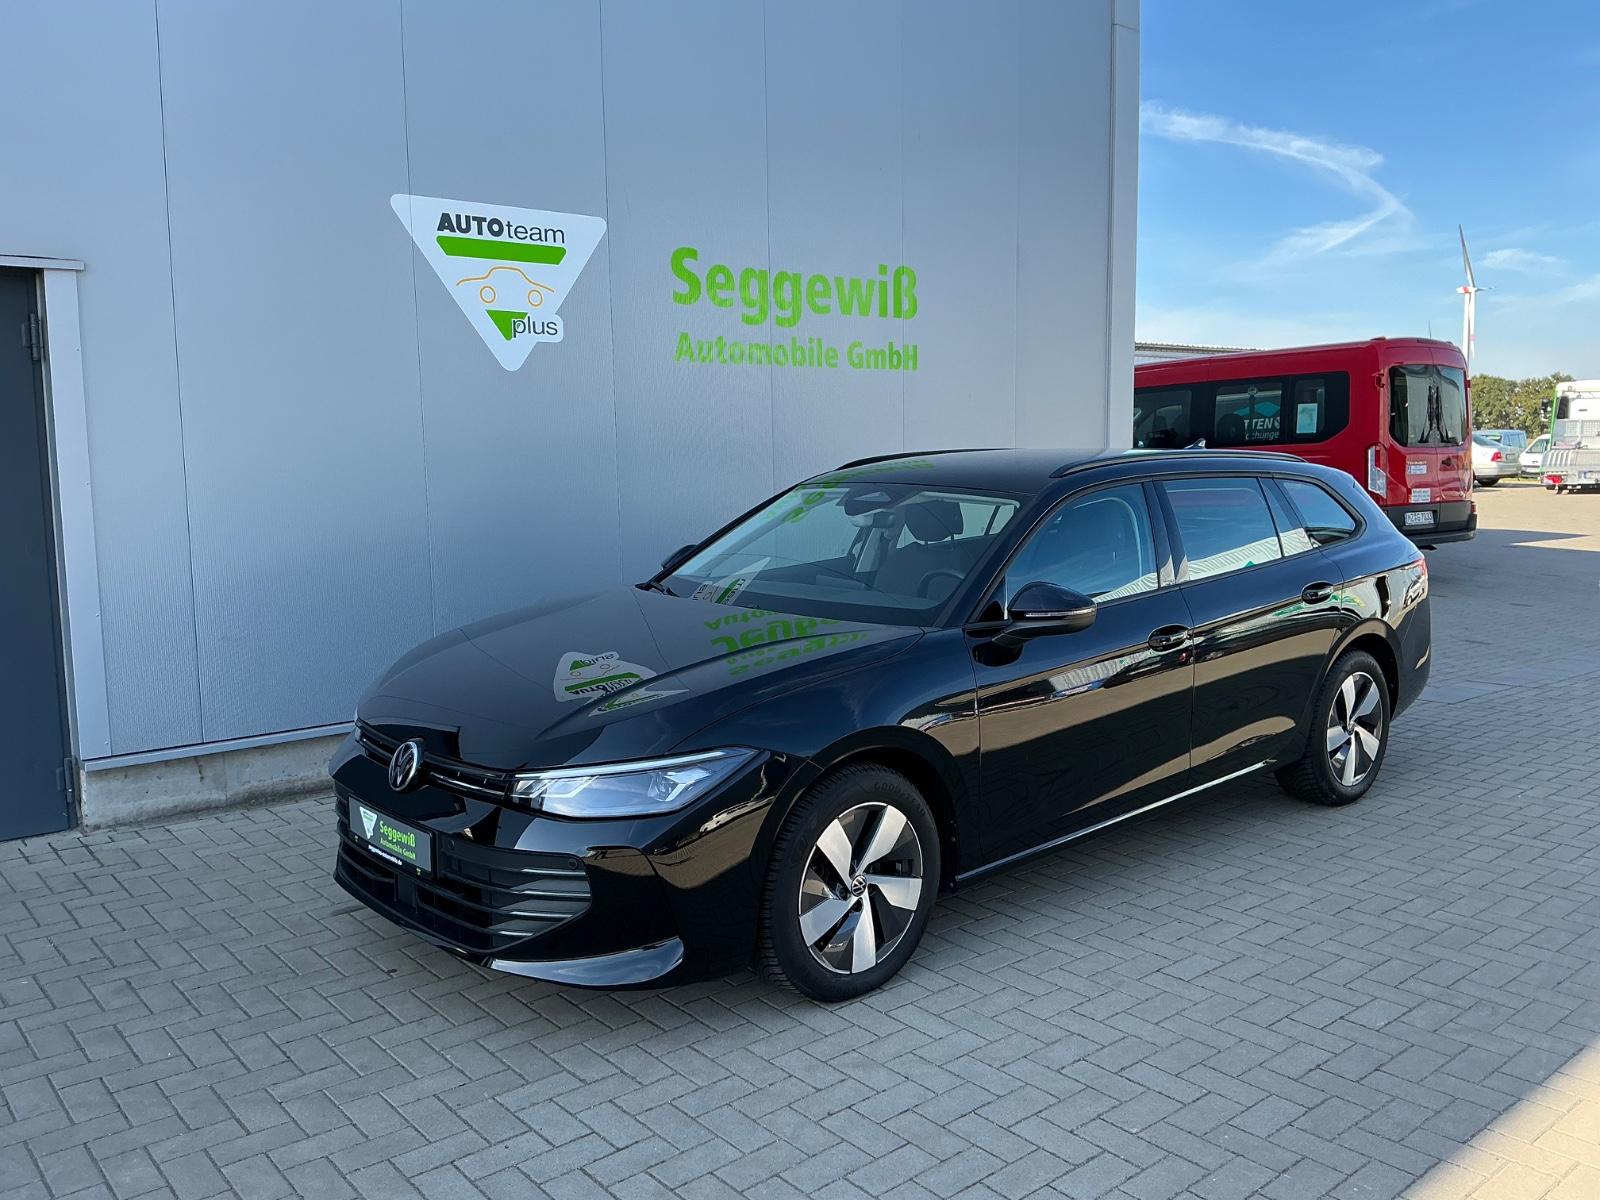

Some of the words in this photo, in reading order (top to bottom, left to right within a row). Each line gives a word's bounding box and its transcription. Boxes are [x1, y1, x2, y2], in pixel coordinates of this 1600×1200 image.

[437, 212, 565, 244] AUTOteam
[670, 246, 918, 328] Seggewiß
[512, 316, 558, 338] plus
[673, 332, 839, 368] Automobile
[847, 340, 918, 371] GmbH
[379, 820, 416, 848] Seggewiß
